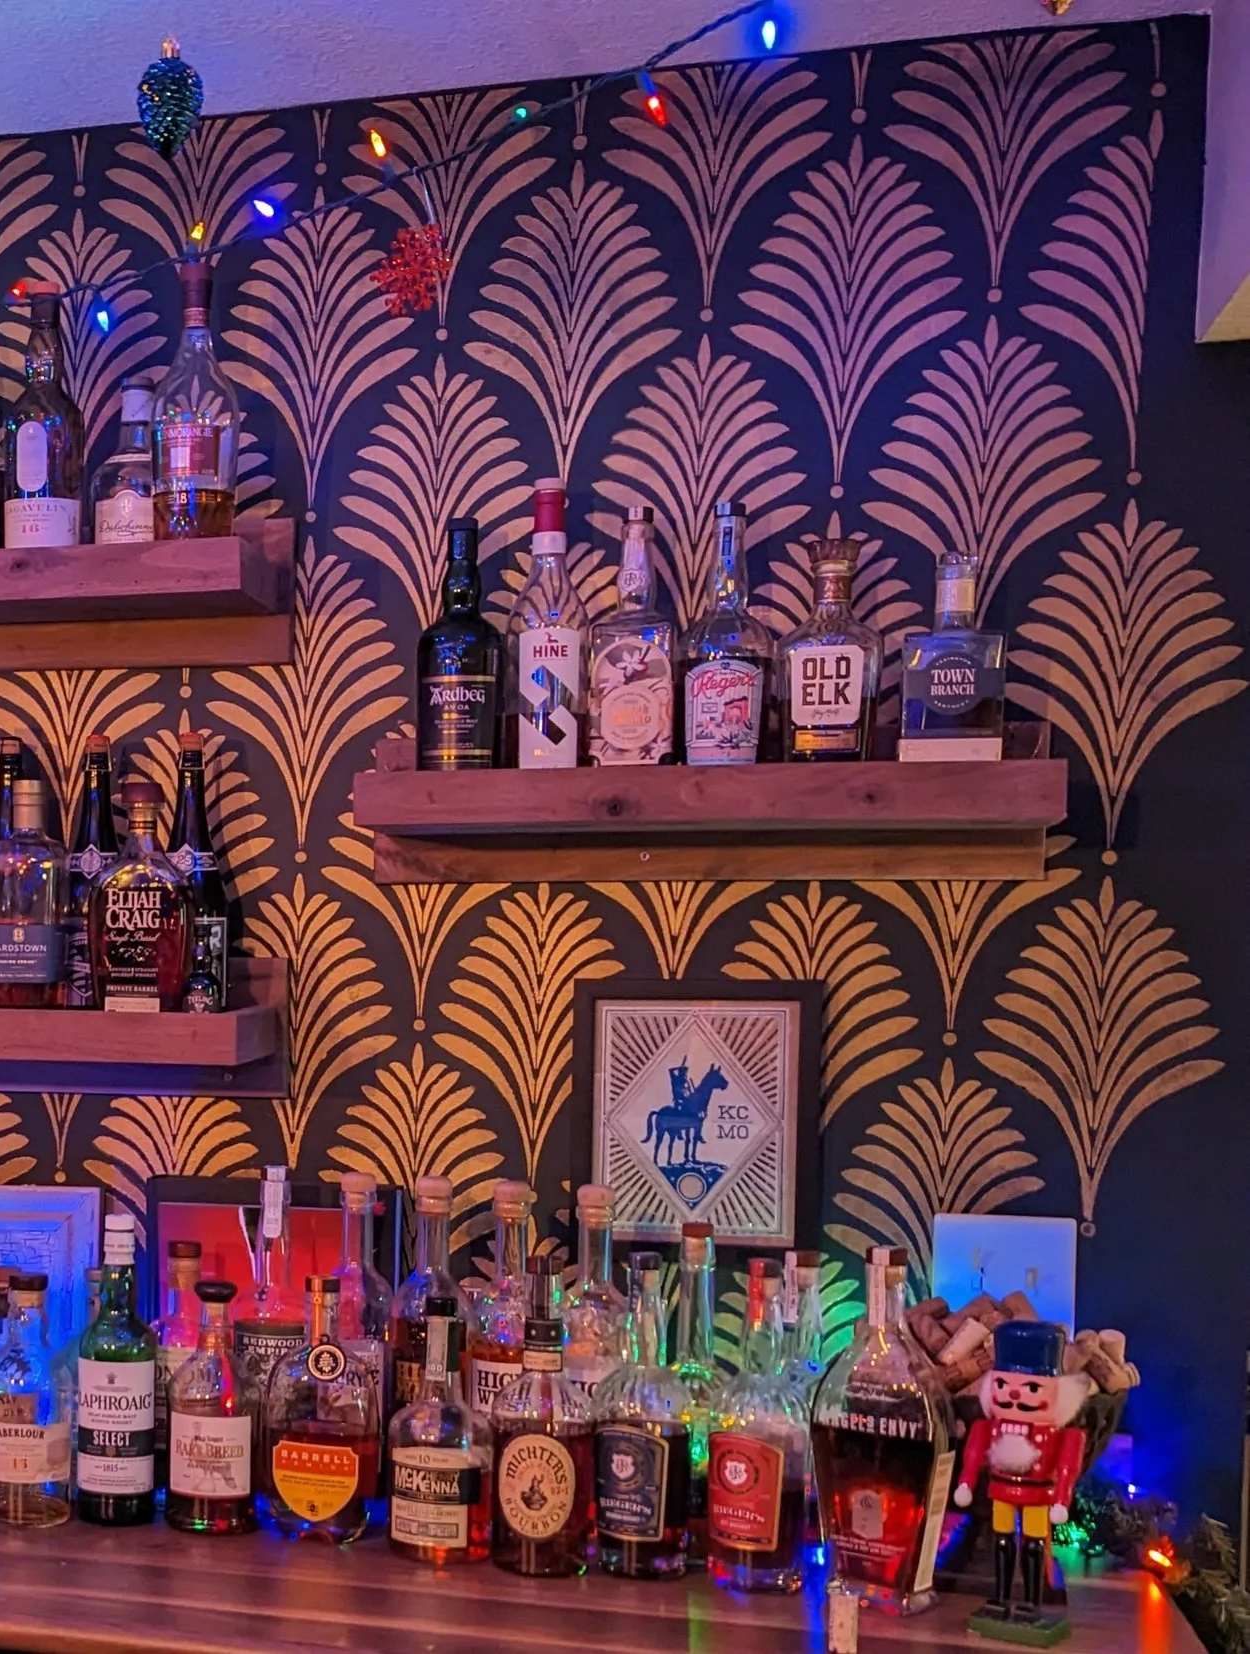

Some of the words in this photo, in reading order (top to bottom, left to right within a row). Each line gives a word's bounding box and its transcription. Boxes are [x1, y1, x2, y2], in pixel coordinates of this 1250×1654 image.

[21, 523, 41, 534] 16
[533, 645, 569, 659] HINE
[802, 653, 851, 681] OLD
[931, 668, 976, 683] TOWN
[802, 682, 851, 706] ELK
[930, 684, 975, 695] BRANCH
[106, 888, 162, 912] ELIJAH
[105, 908, 161, 931] CRAIG
[130, 930, 162, 942] Barrel
[716, 1105, 750, 1120] KC
[716, 1124, 749, 1140] MO
[242, 1336, 303, 1348] REDWOOD
[247, 1345, 291, 1355] EMPIR
[477, 1370, 523, 1391] HIG
[78, 1391, 153, 1412] LAPHROAIG
[879, 1417, 918, 1440] ENVY
[92, 1430, 131, 1447] SELECT
[205, 1442, 244, 1459] BREED
[280, 1449, 351, 1465] BARRELL
[419, 1454, 431, 1464] 10
[505, 1445, 568, 1484] MICHTER'S
[102, 1463, 119, 1473] 1815
[505, 1497, 567, 1530] BOURBON
